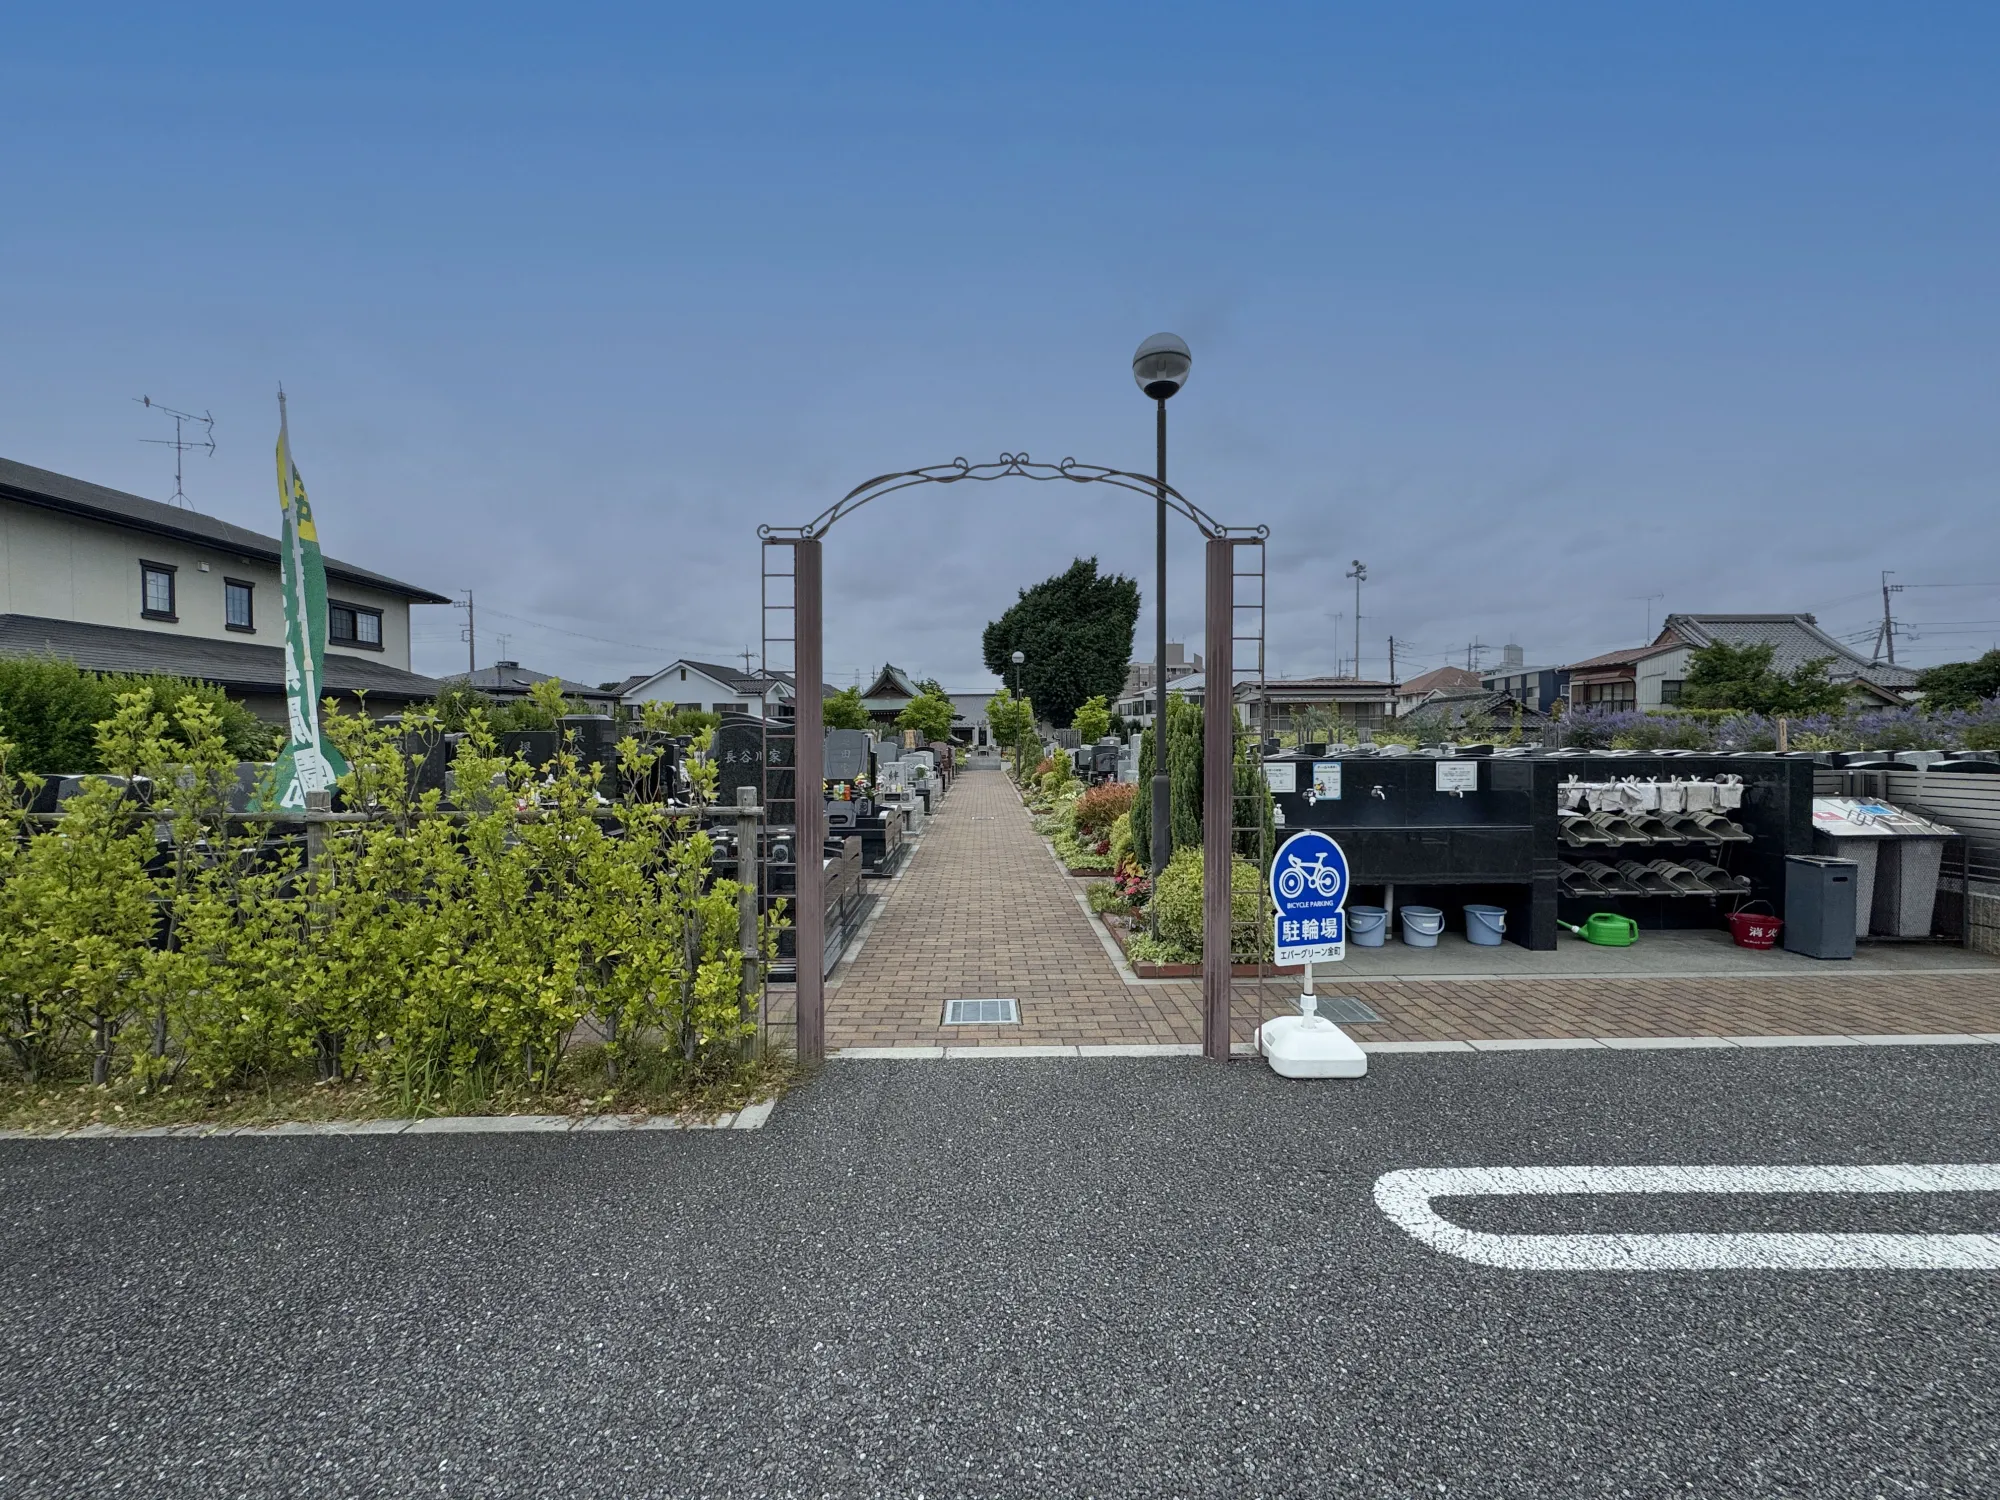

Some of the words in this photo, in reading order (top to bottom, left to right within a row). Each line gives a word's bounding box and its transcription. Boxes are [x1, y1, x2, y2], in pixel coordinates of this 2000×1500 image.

[724, 749, 782, 764] 長谷川家
[1287, 901, 1309, 909] BICYCLE
[1310, 900, 1334, 908] PARKING
[1282, 917, 1338, 942] 駐輪場
[1748, 926, 1778, 938] 消火
[1280, 946, 1341, 960] エバーグリーン金町
